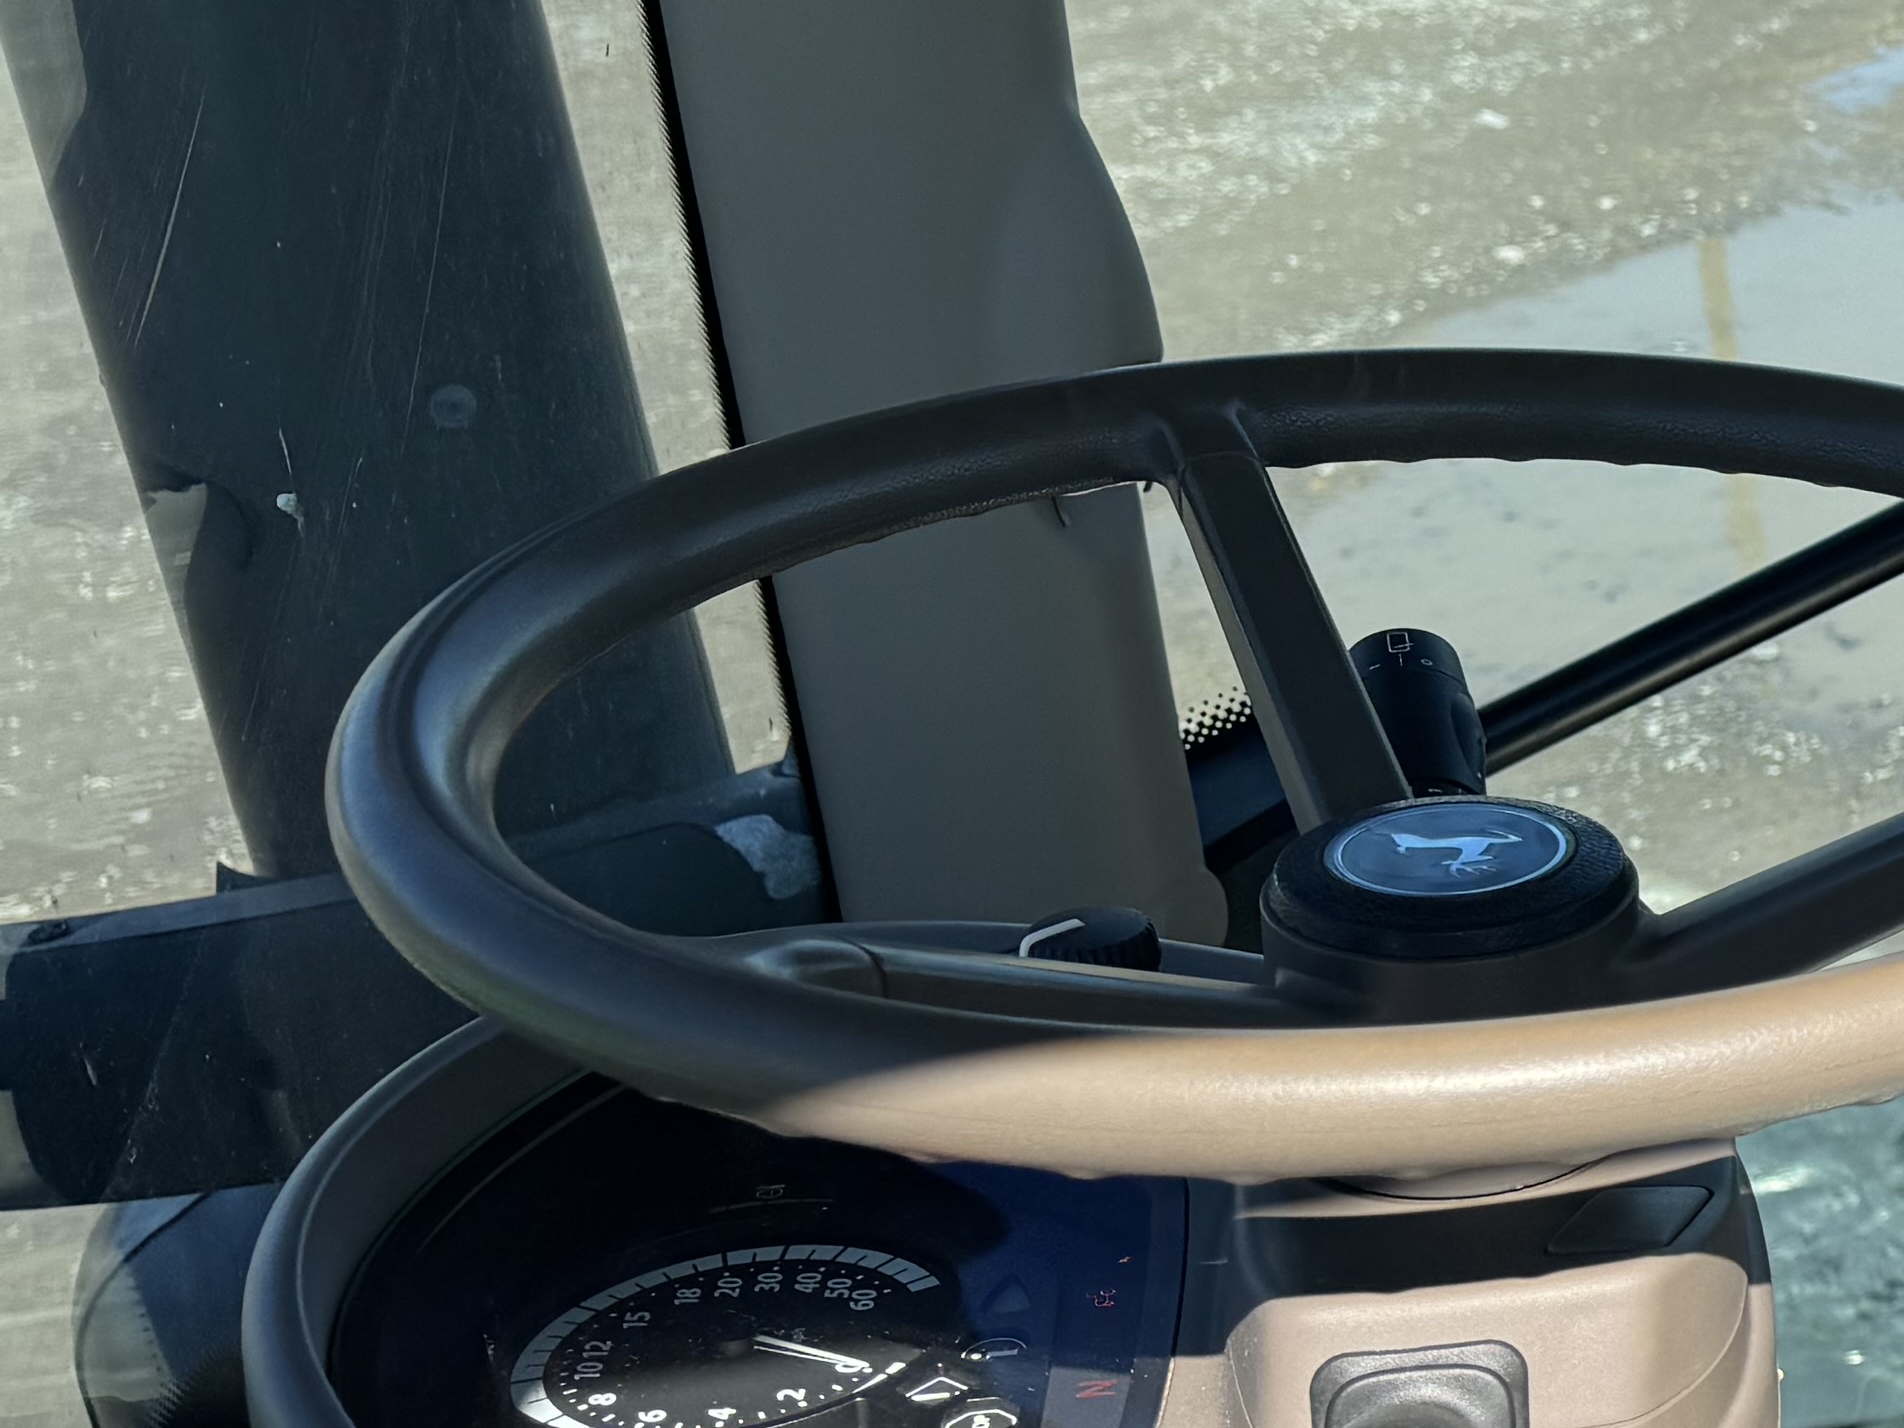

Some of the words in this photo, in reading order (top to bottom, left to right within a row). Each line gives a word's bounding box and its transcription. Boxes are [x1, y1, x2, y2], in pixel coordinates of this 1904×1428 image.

[714, 1277, 743, 1298] 20
[754, 1272, 783, 1292] 30
[794, 1272, 823, 1293] 40
[824, 1278, 853, 1299] 50
[674, 1287, 701, 1305] 18
[850, 1289, 877, 1311] 60
[623, 1311, 651, 1329] 15
[582, 1340, 612, 1360] 12
[574, 1361, 604, 1380] 10
[776, 1388, 806, 1401] 2
[1075, 1379, 1119, 1399] N
[588, 1392, 617, 1406] 8
[638, 1409, 667, 1423] 6
[708, 1407, 737, 1420] 4
